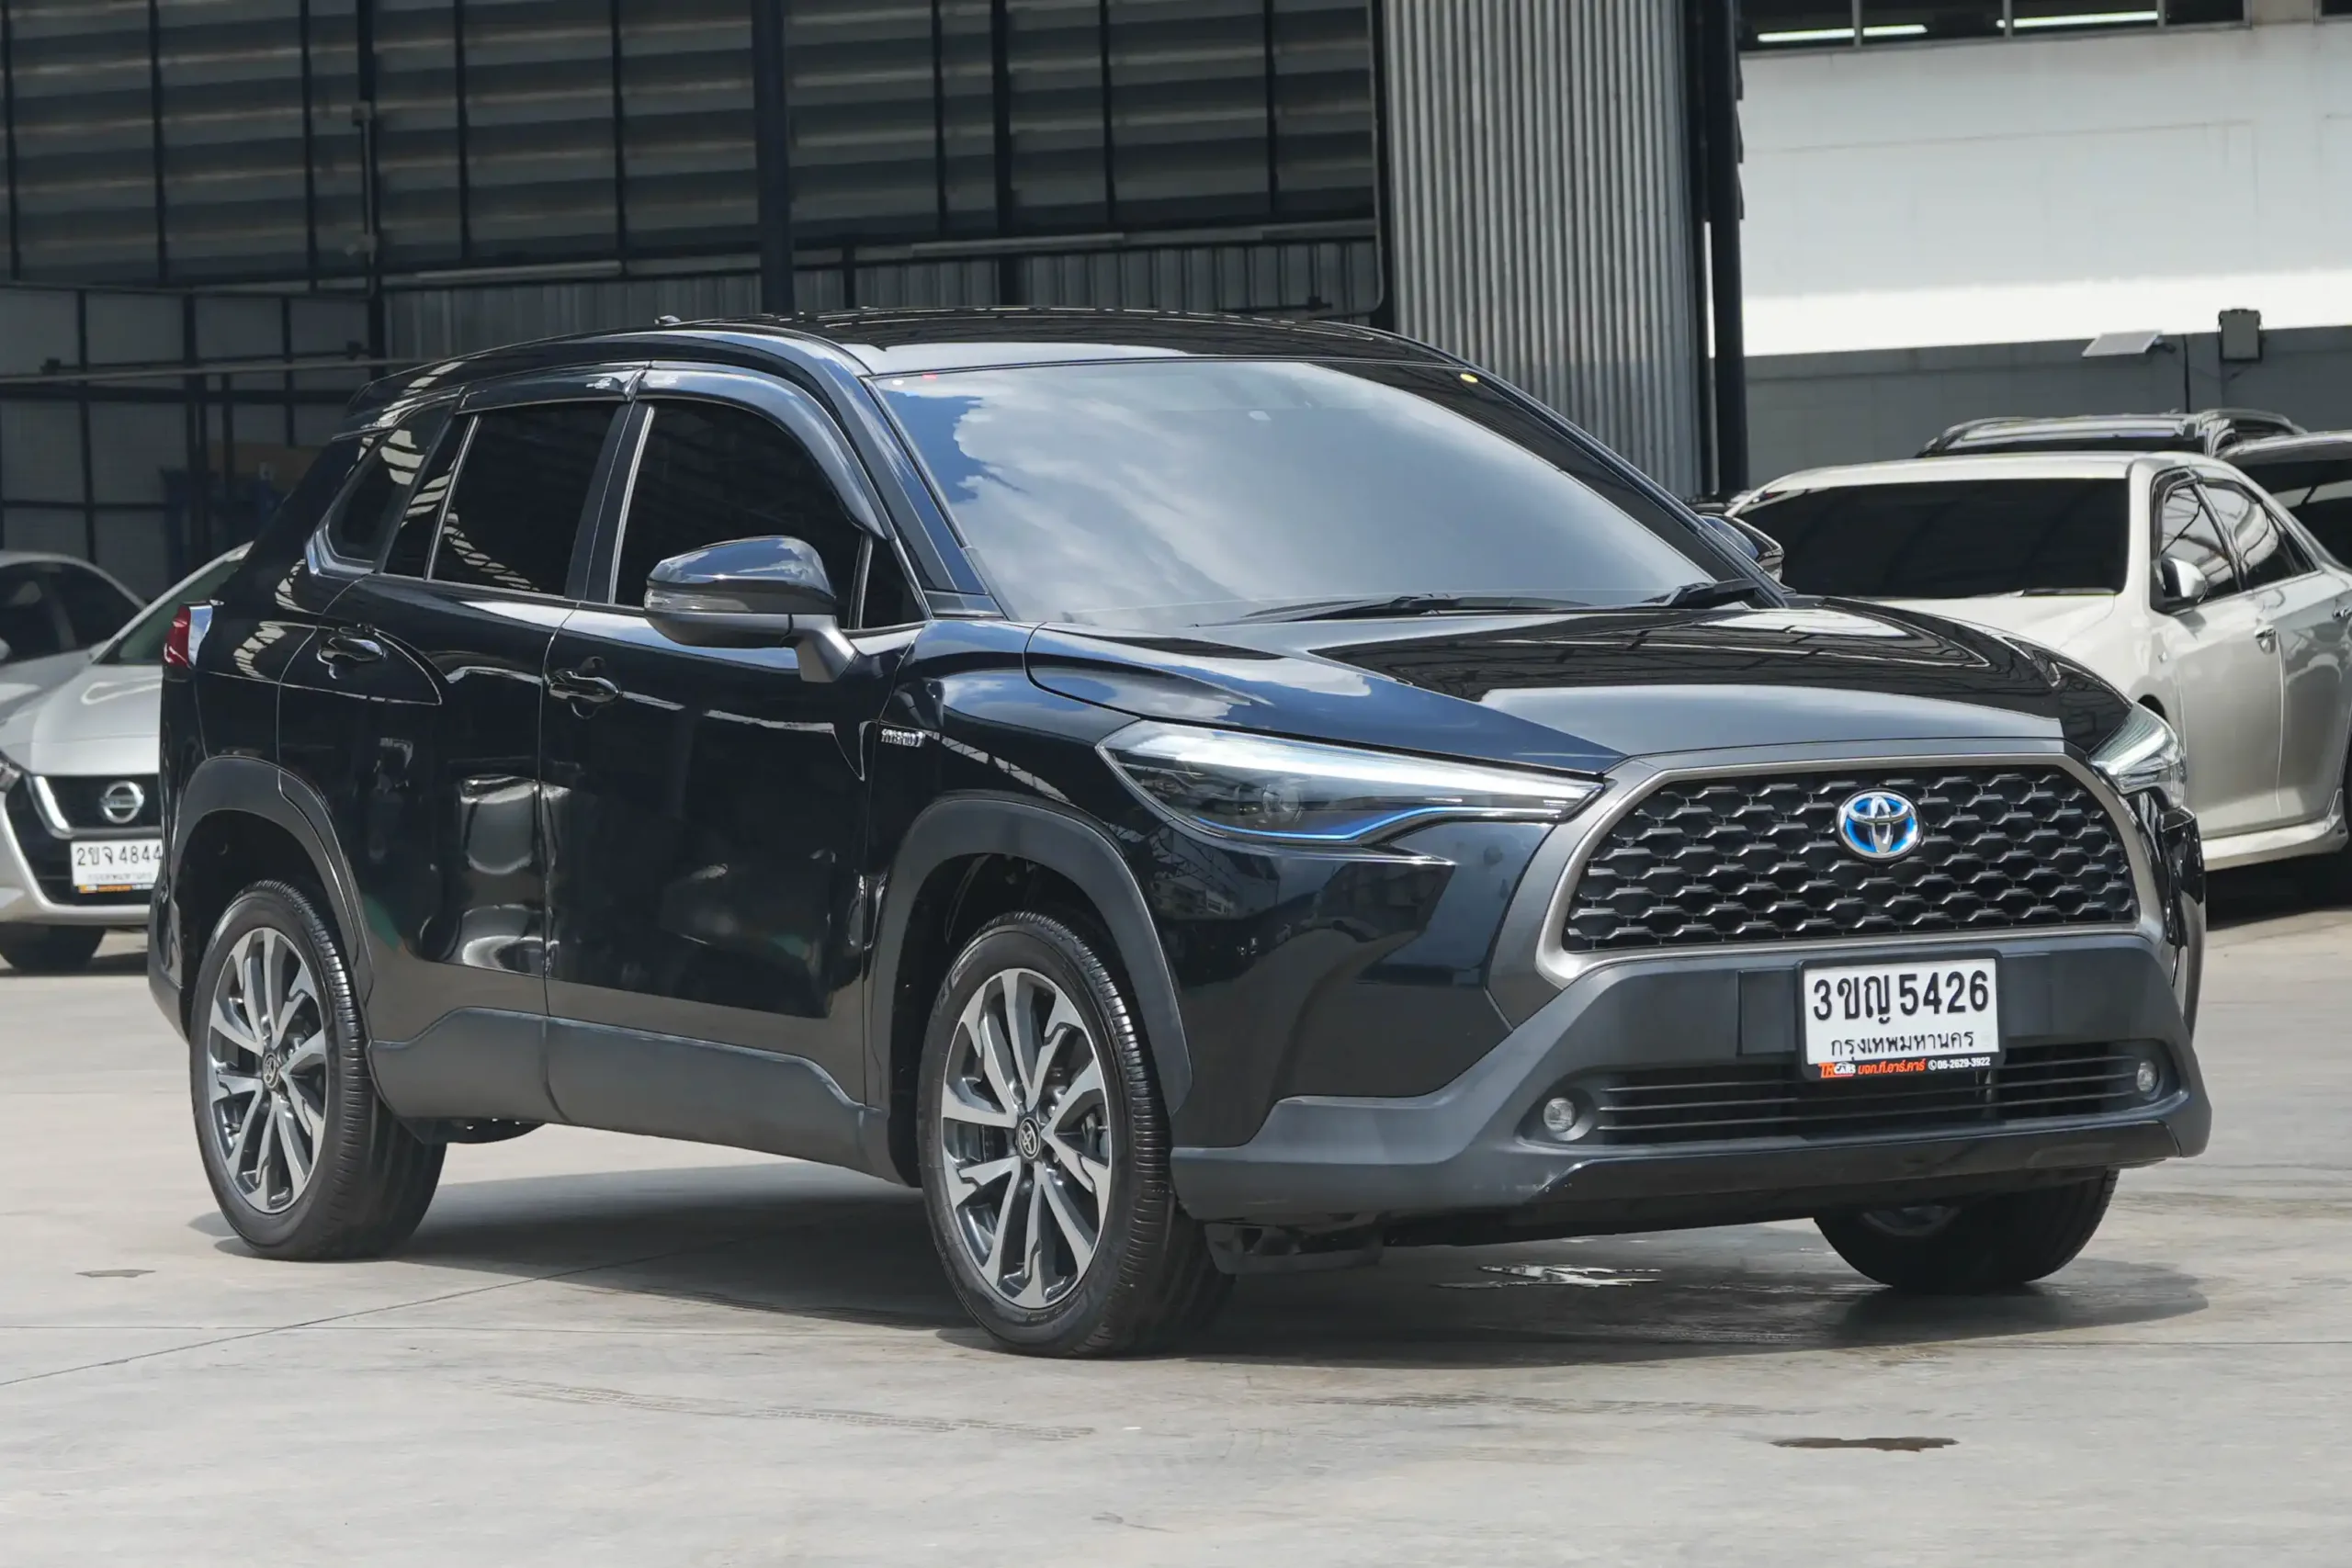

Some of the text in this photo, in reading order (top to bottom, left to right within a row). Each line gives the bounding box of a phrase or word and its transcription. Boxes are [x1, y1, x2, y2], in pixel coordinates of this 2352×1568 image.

[1813, 969, 1989, 1024] 3ขญ 5426
[1831, 1031, 1974, 1061] กรุงเทพมหานคร
